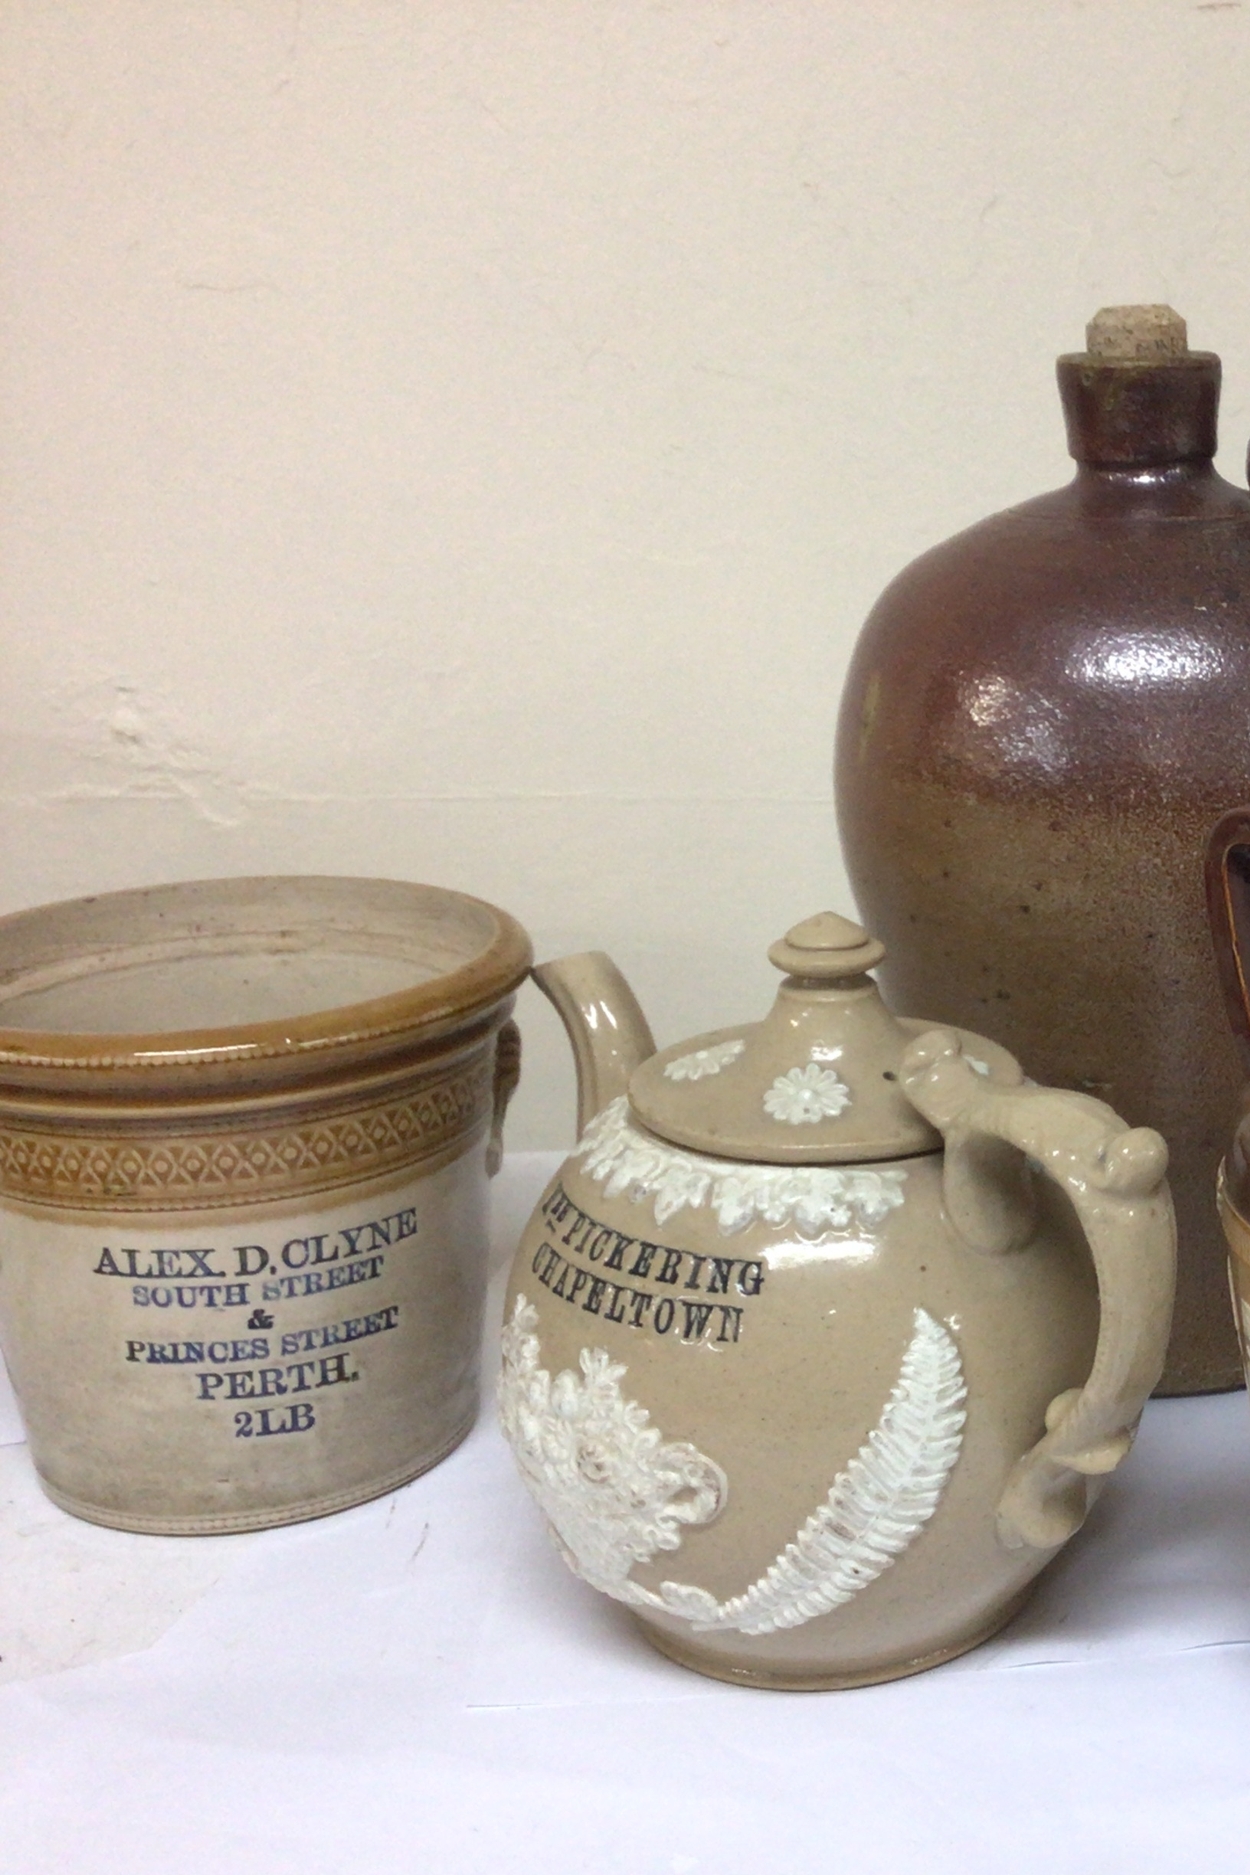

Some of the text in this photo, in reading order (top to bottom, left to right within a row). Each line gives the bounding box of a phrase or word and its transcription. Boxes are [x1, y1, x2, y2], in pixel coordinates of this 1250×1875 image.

[94, 1208, 418, 1278] ALEX. D. CLYNE
[561, 1212, 765, 1296] PICKERING
[132, 1255, 385, 1308] SOUTH STREET
[531, 1241, 744, 1343] CHAPELTOWN
[125, 1306, 400, 1364] PRINCES STREET
[247, 1309, 275, 1329] &
[196, 1353, 360, 1400] PERTH.
[234, 1403, 316, 1438] 2LB
